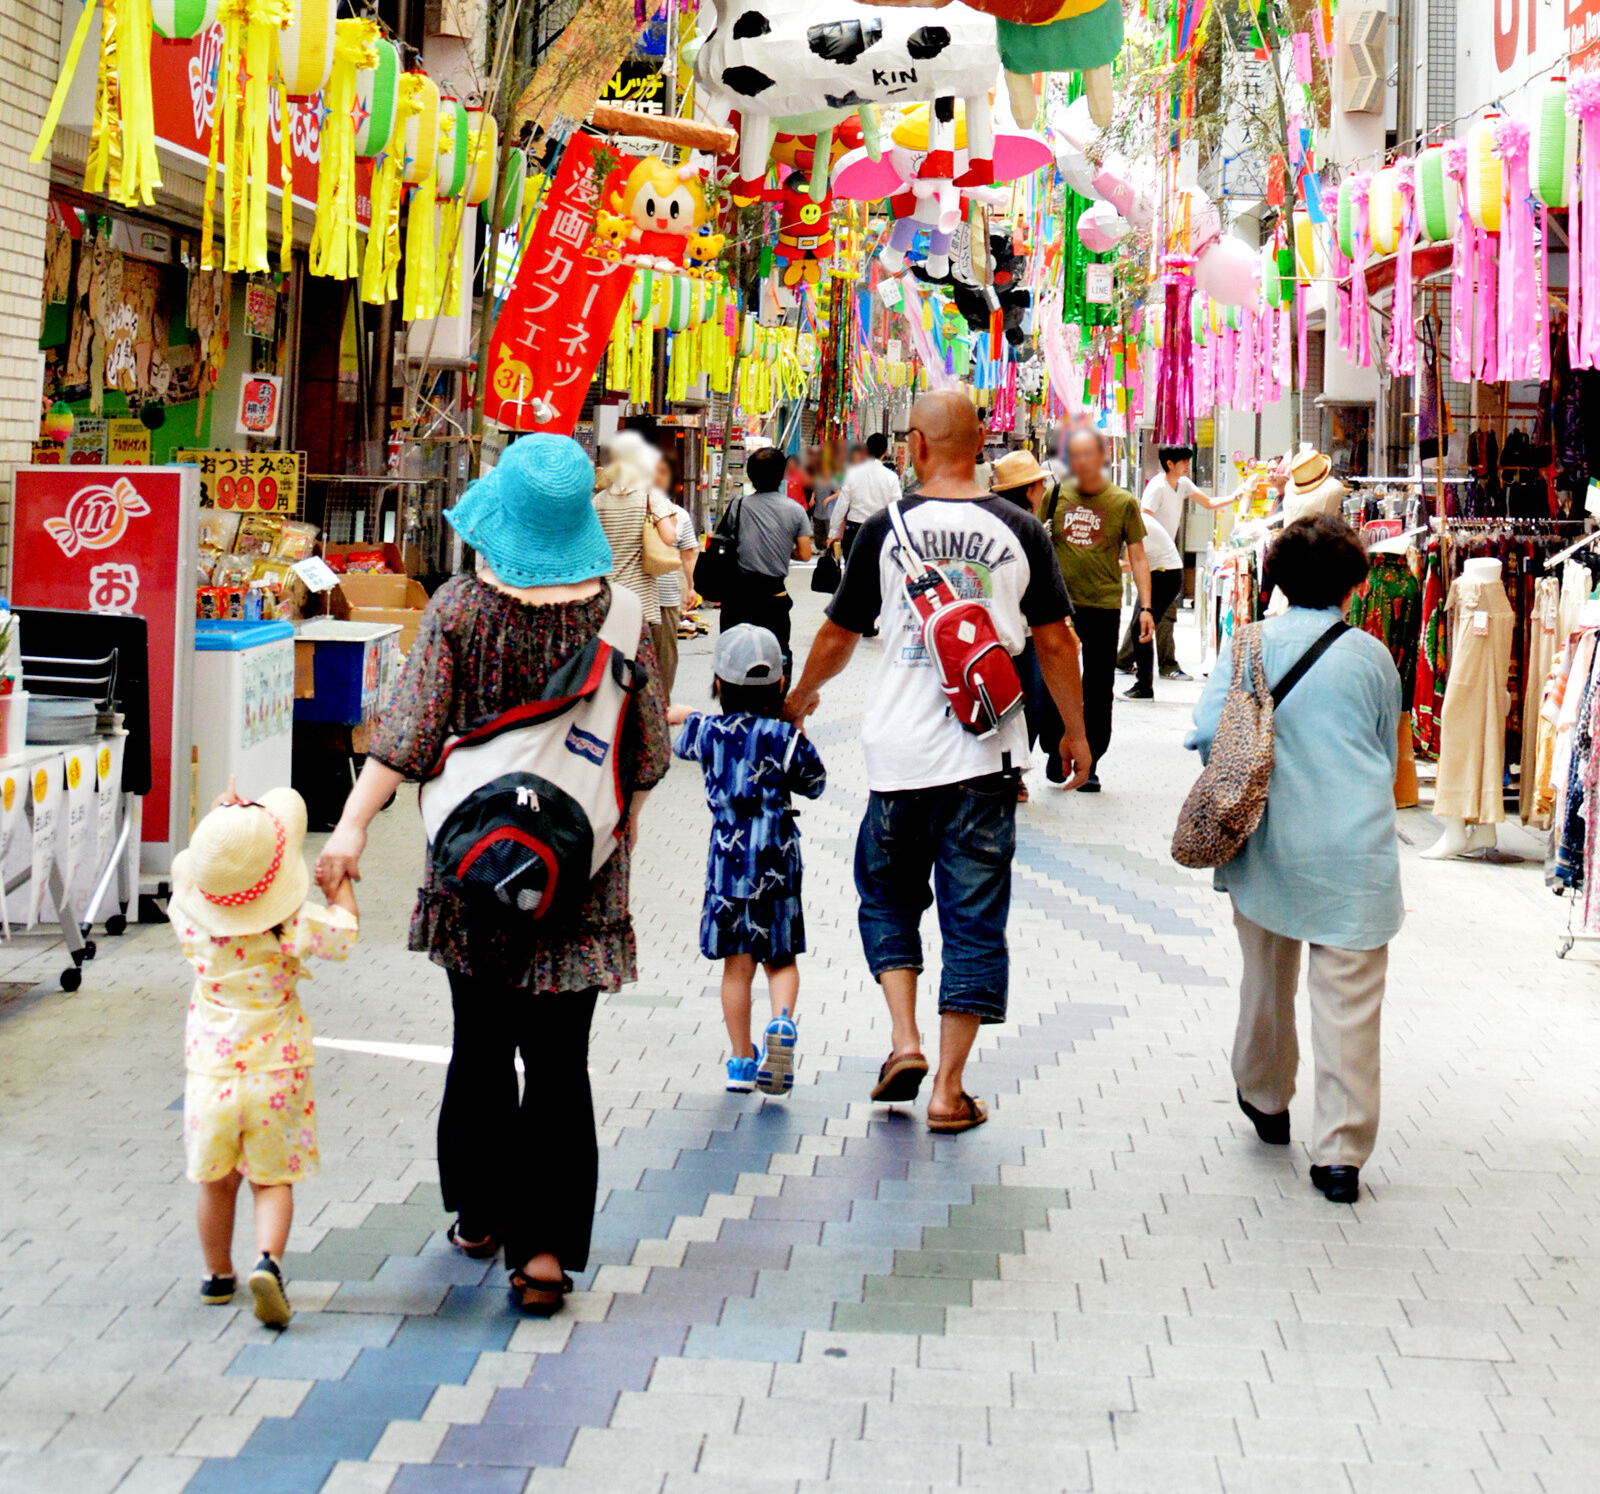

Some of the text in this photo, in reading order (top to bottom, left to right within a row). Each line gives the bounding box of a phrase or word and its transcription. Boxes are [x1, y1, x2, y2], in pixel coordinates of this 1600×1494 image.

[872, 67, 918, 86] KIN
[516, 161, 597, 352] 漫画カフェ
[259, 384, 272, 427] おつまみ
[200, 455, 277, 476] おつまみ
